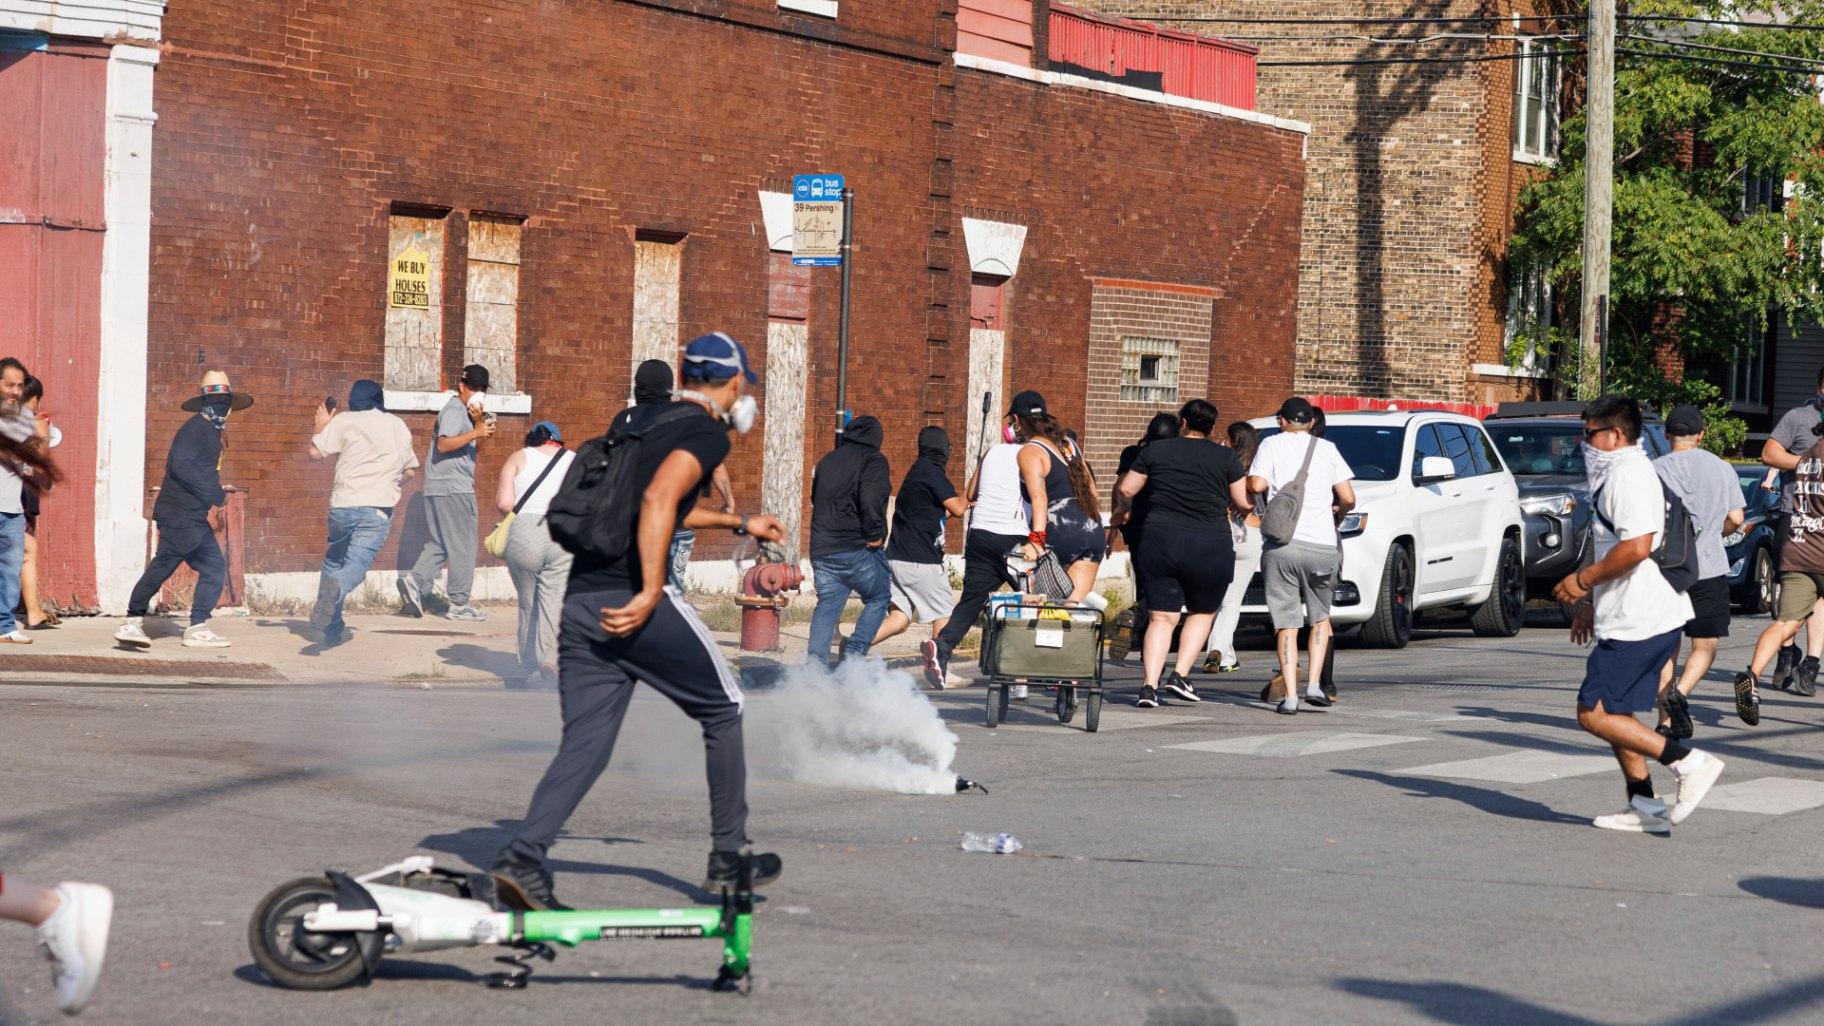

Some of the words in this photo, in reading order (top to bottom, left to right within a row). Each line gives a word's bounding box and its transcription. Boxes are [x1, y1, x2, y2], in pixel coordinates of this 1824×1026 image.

[824, 178, 839, 187] bus
[824, 188, 842, 198] stop
[794, 203, 804, 212] 39
[805, 204, 834, 213] Pershing
[397, 260, 408, 273] WE
[410, 261, 426, 275] BUY
[395, 279, 426, 293] HOUSES
